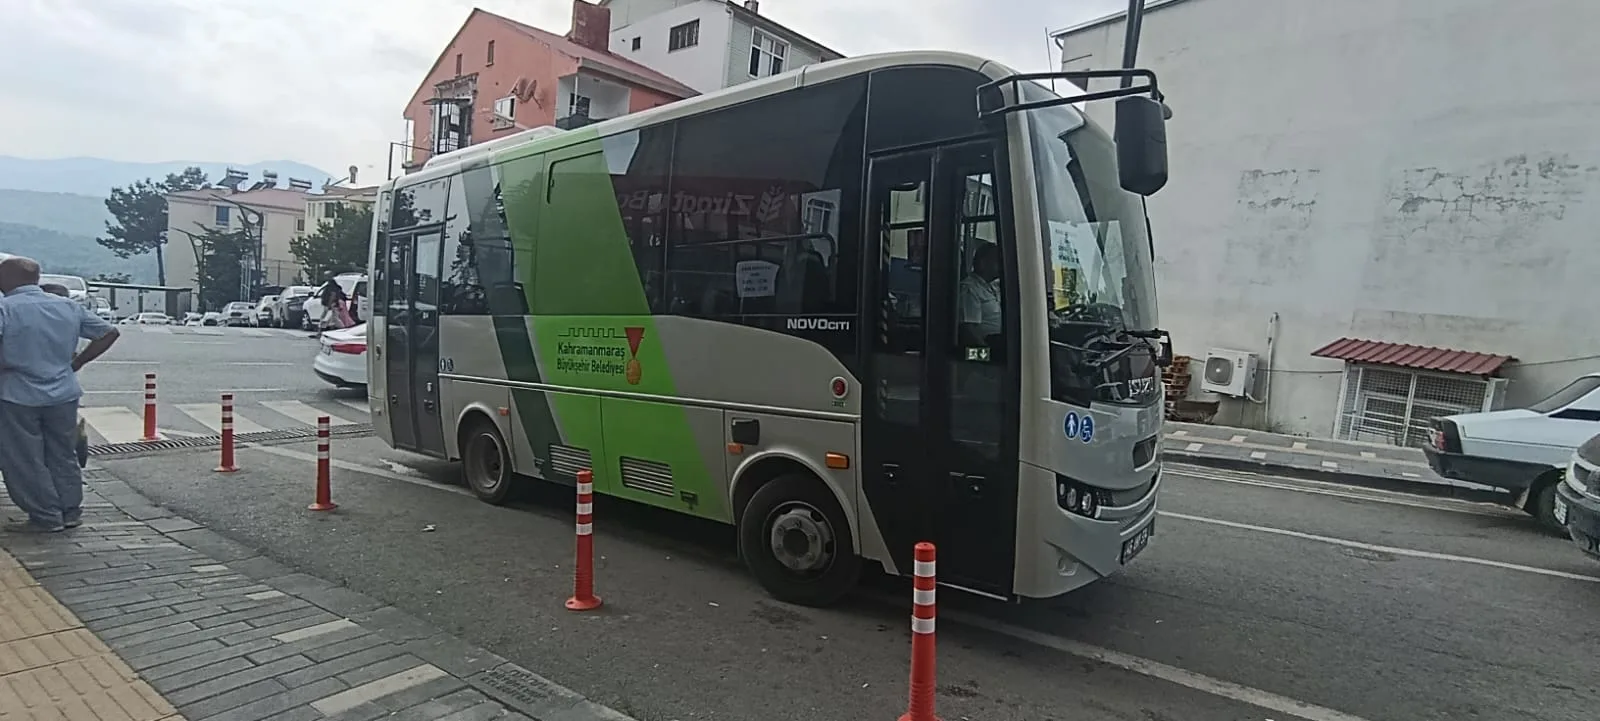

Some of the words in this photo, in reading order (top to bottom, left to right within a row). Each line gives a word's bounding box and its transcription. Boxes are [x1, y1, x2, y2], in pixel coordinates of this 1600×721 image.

[557, 342, 625, 360] Kahramanmaraş
[557, 358, 590, 374] Büyükşehir
[591, 360, 625, 376] Belediyesi
